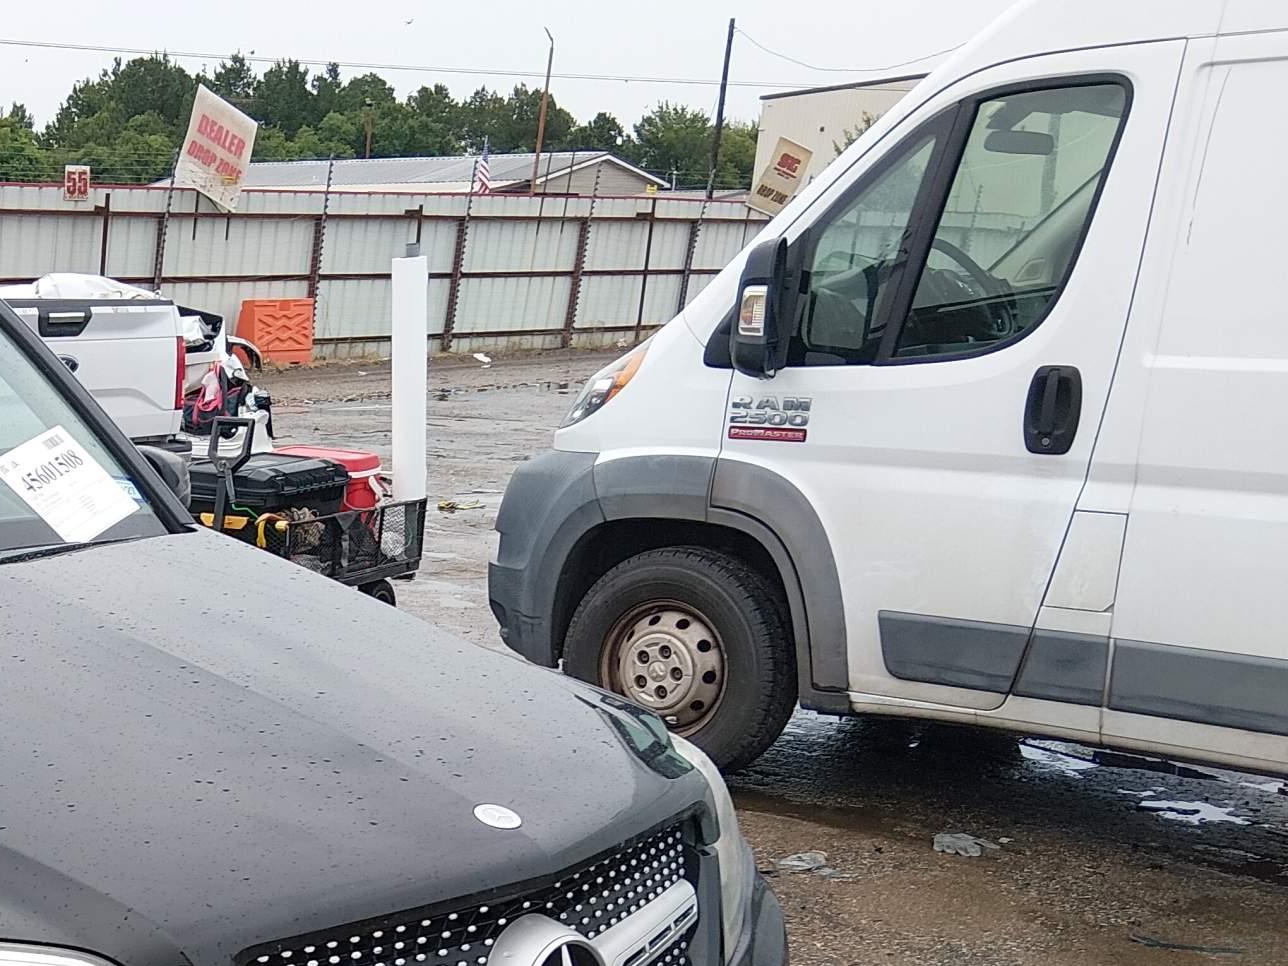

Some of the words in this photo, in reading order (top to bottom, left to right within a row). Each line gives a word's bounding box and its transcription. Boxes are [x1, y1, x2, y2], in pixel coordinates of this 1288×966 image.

[198, 114, 246, 160] DEALER
[187, 140, 217, 168] DROP
[215, 158, 243, 185] ZONE
[67, 171, 88, 195] 55
[757, 184, 776, 199] DROP
[771, 190, 789, 205] ZONE
[731, 395, 812, 412] RAM
[729, 410, 809, 427] 2500
[21, 449, 84, 493] 45601508
